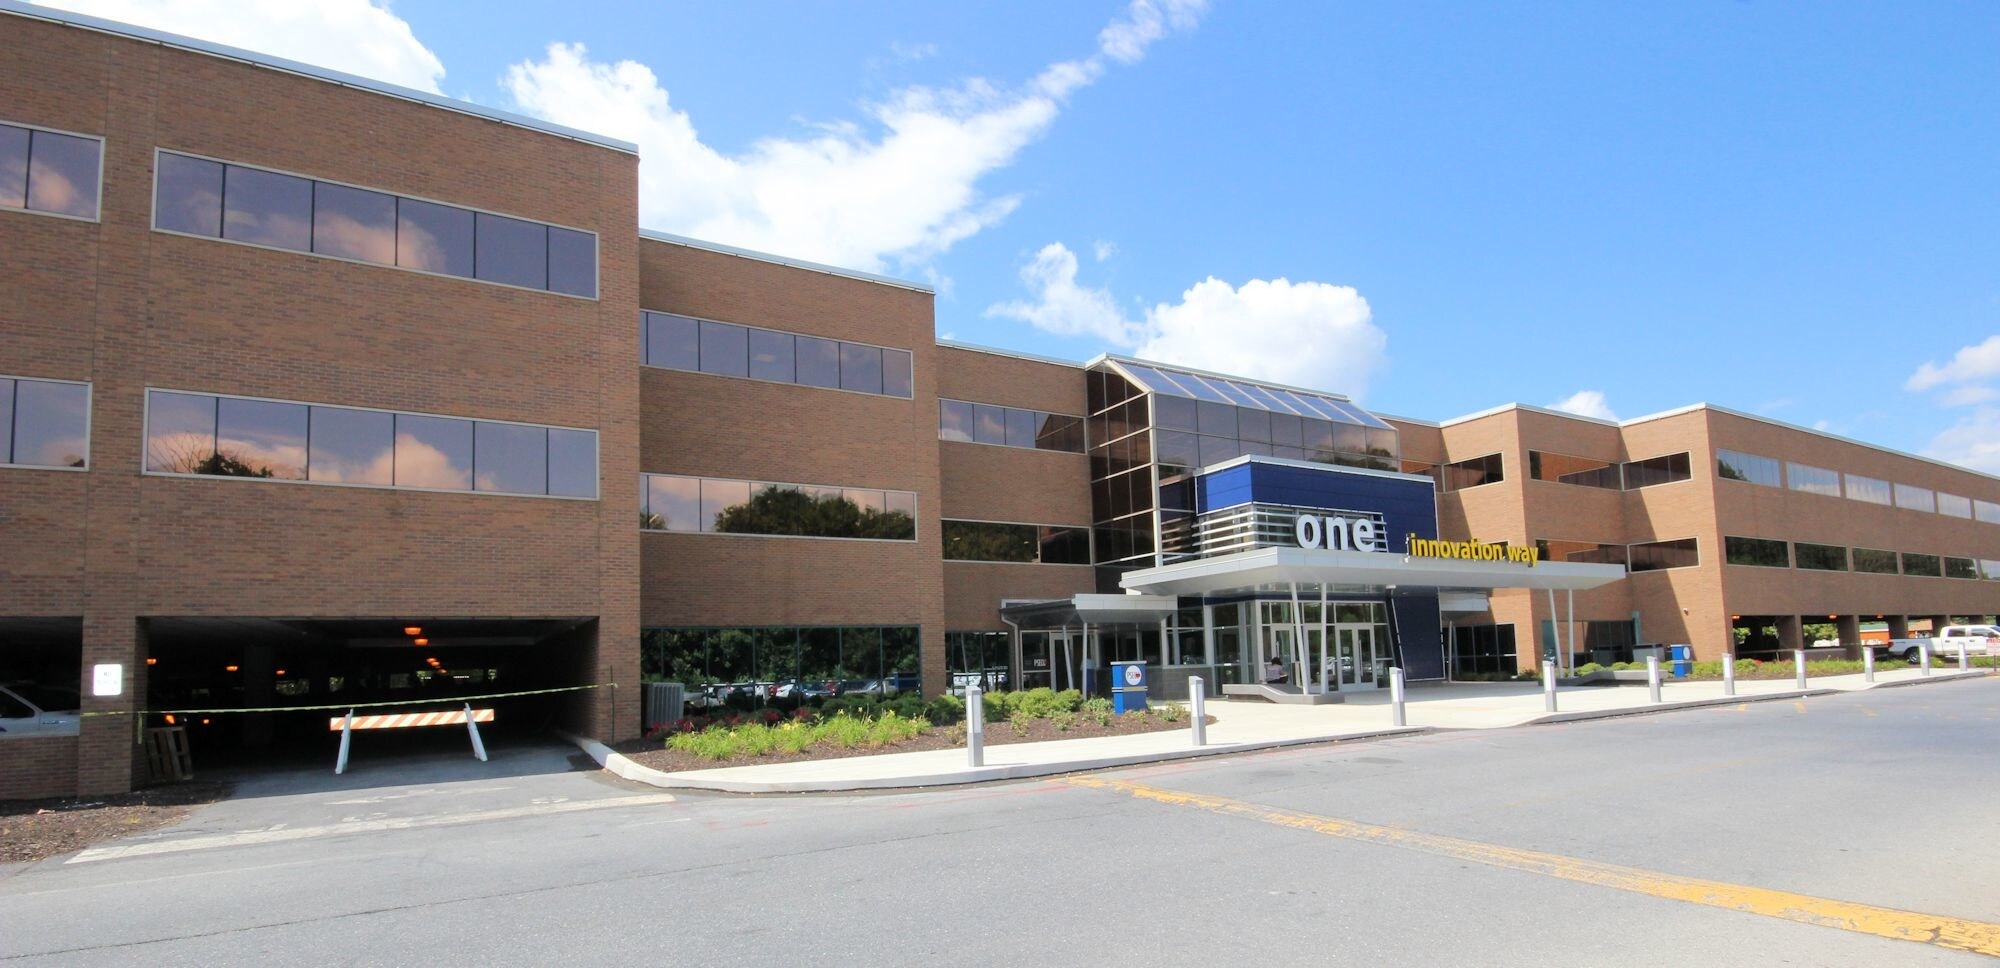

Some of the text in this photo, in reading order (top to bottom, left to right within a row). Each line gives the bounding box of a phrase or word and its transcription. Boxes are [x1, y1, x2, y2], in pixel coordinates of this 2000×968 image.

[1296, 514, 1375, 552] one
[1410, 533, 1539, 567] innovation way
